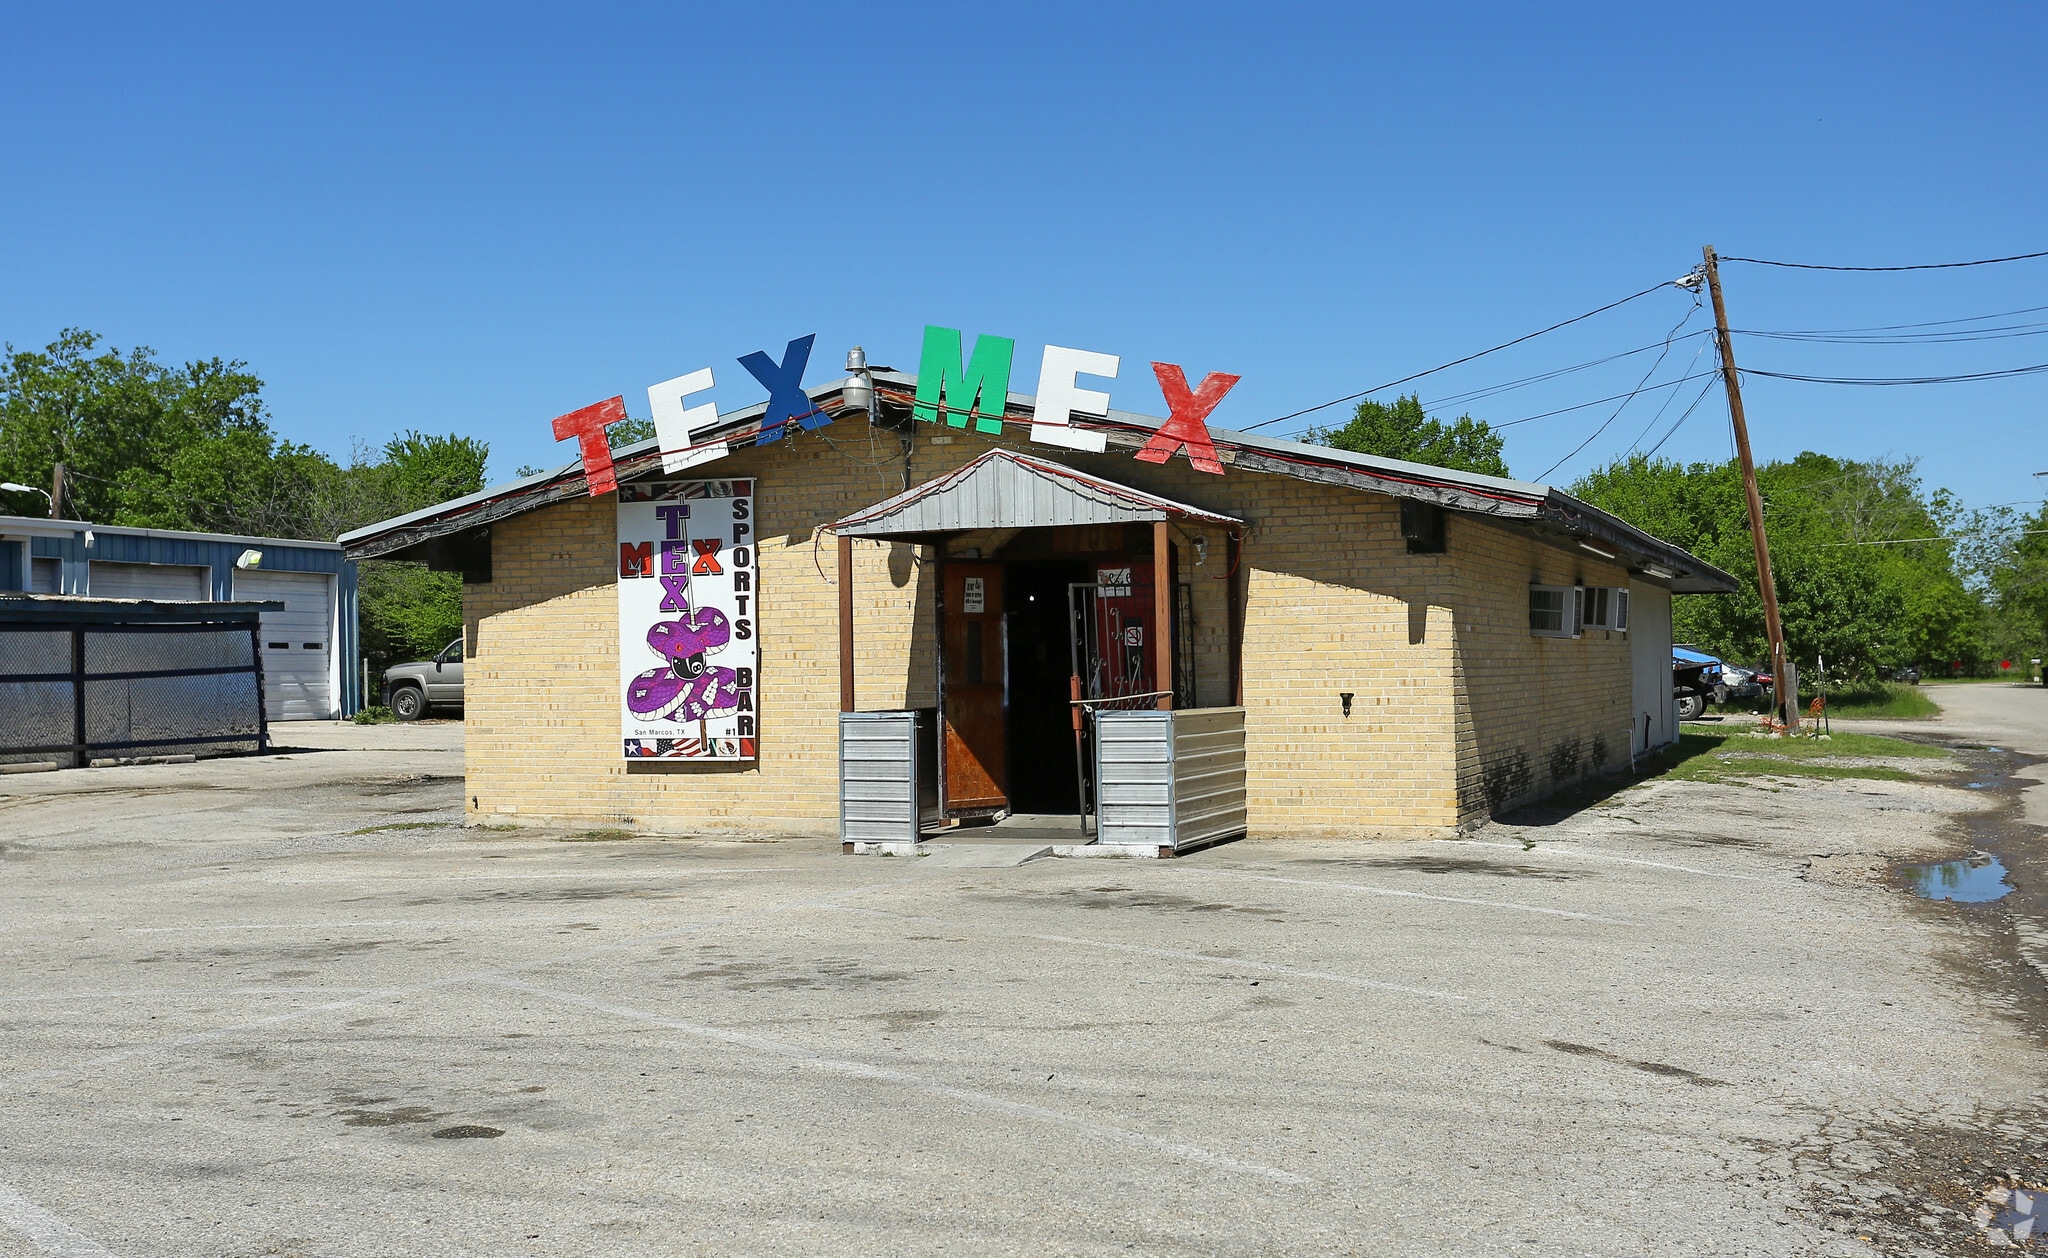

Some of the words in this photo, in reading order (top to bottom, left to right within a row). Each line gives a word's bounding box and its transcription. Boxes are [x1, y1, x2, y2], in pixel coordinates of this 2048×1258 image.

[552, 333, 834, 497] TEX
[913, 325, 1241, 475] MEX
[656, 504, 691, 613] TEX
[732, 498, 751, 640] SPORTS
[692, 663, 702, 674] 8
[736, 667, 754, 736] BAR
[725, 728, 736, 736] #1
